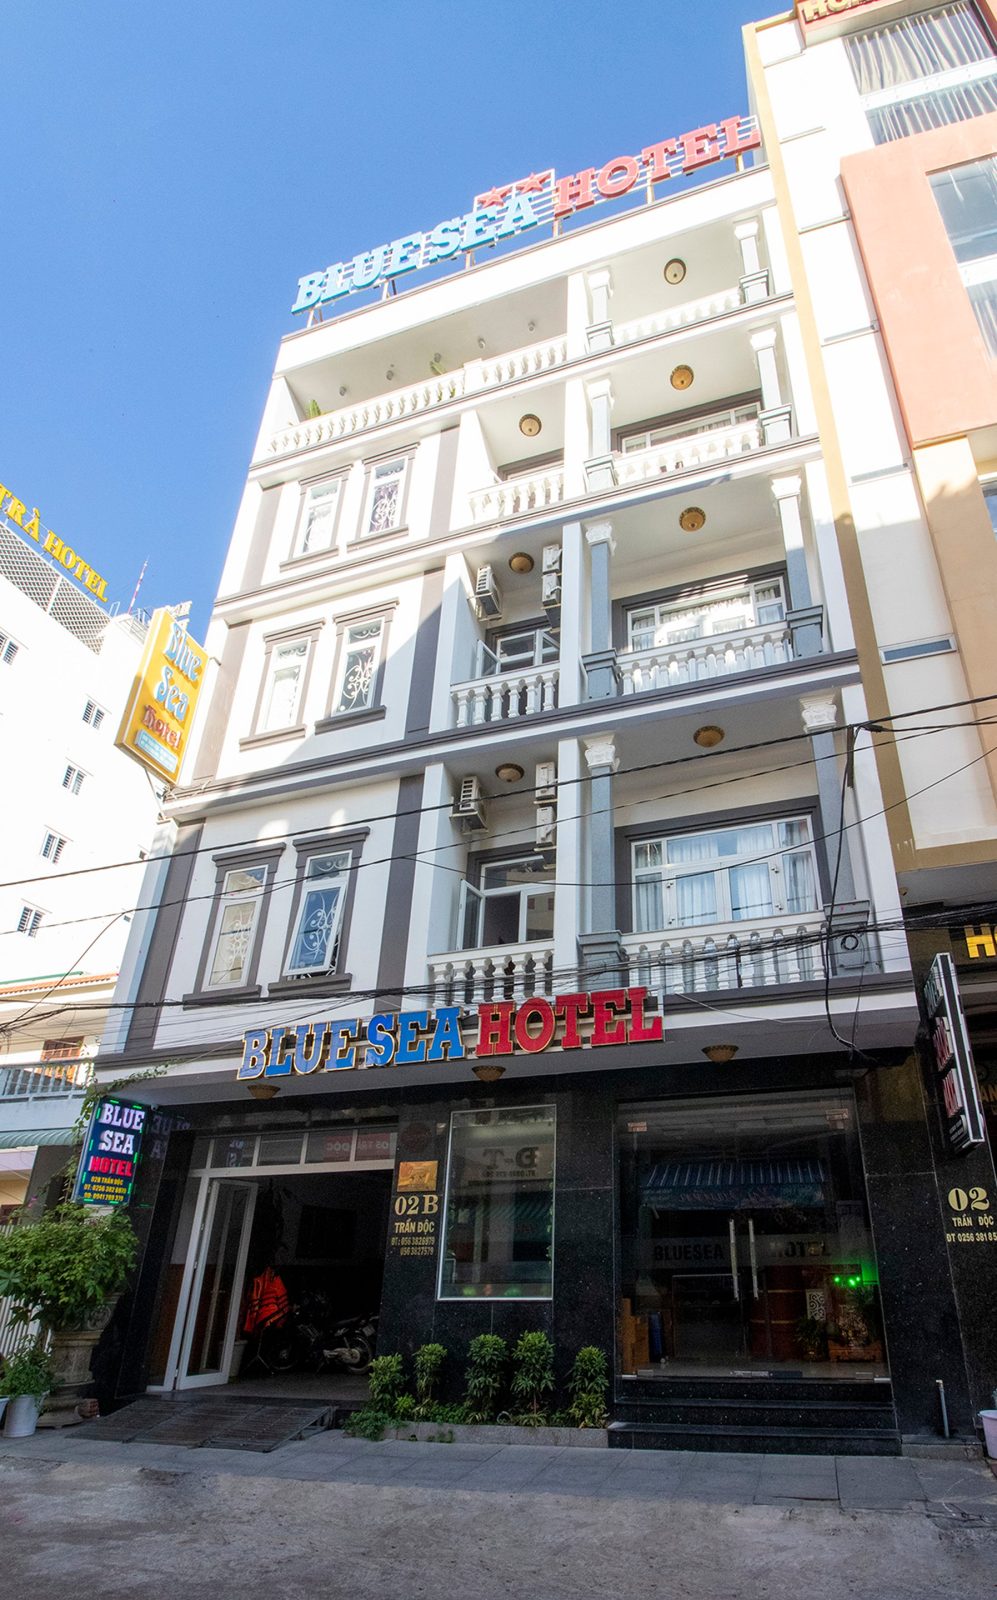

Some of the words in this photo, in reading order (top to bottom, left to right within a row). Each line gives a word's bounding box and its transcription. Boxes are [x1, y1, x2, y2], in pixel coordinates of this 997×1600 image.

[292, 231, 421, 314] BLUE
[430, 194, 538, 262] SEA
[554, 115, 762, 218] HOTEL
[42, 530, 109, 602] HOTEL
[164, 622, 202, 681] Blue
[155, 666, 189, 721] Sea
[236, 1016, 363, 1080] BLUE
[366, 1005, 466, 1068] SEA
[475, 986, 664, 1058] HOTEL
[99, 1103, 145, 1130] BLUE
[98, 1129, 135, 1155] SEA
[88, 1155, 132, 1177] HOTEL
[948, 1187, 990, 1211] 02
[957, 1232, 974, 1242] 0256
